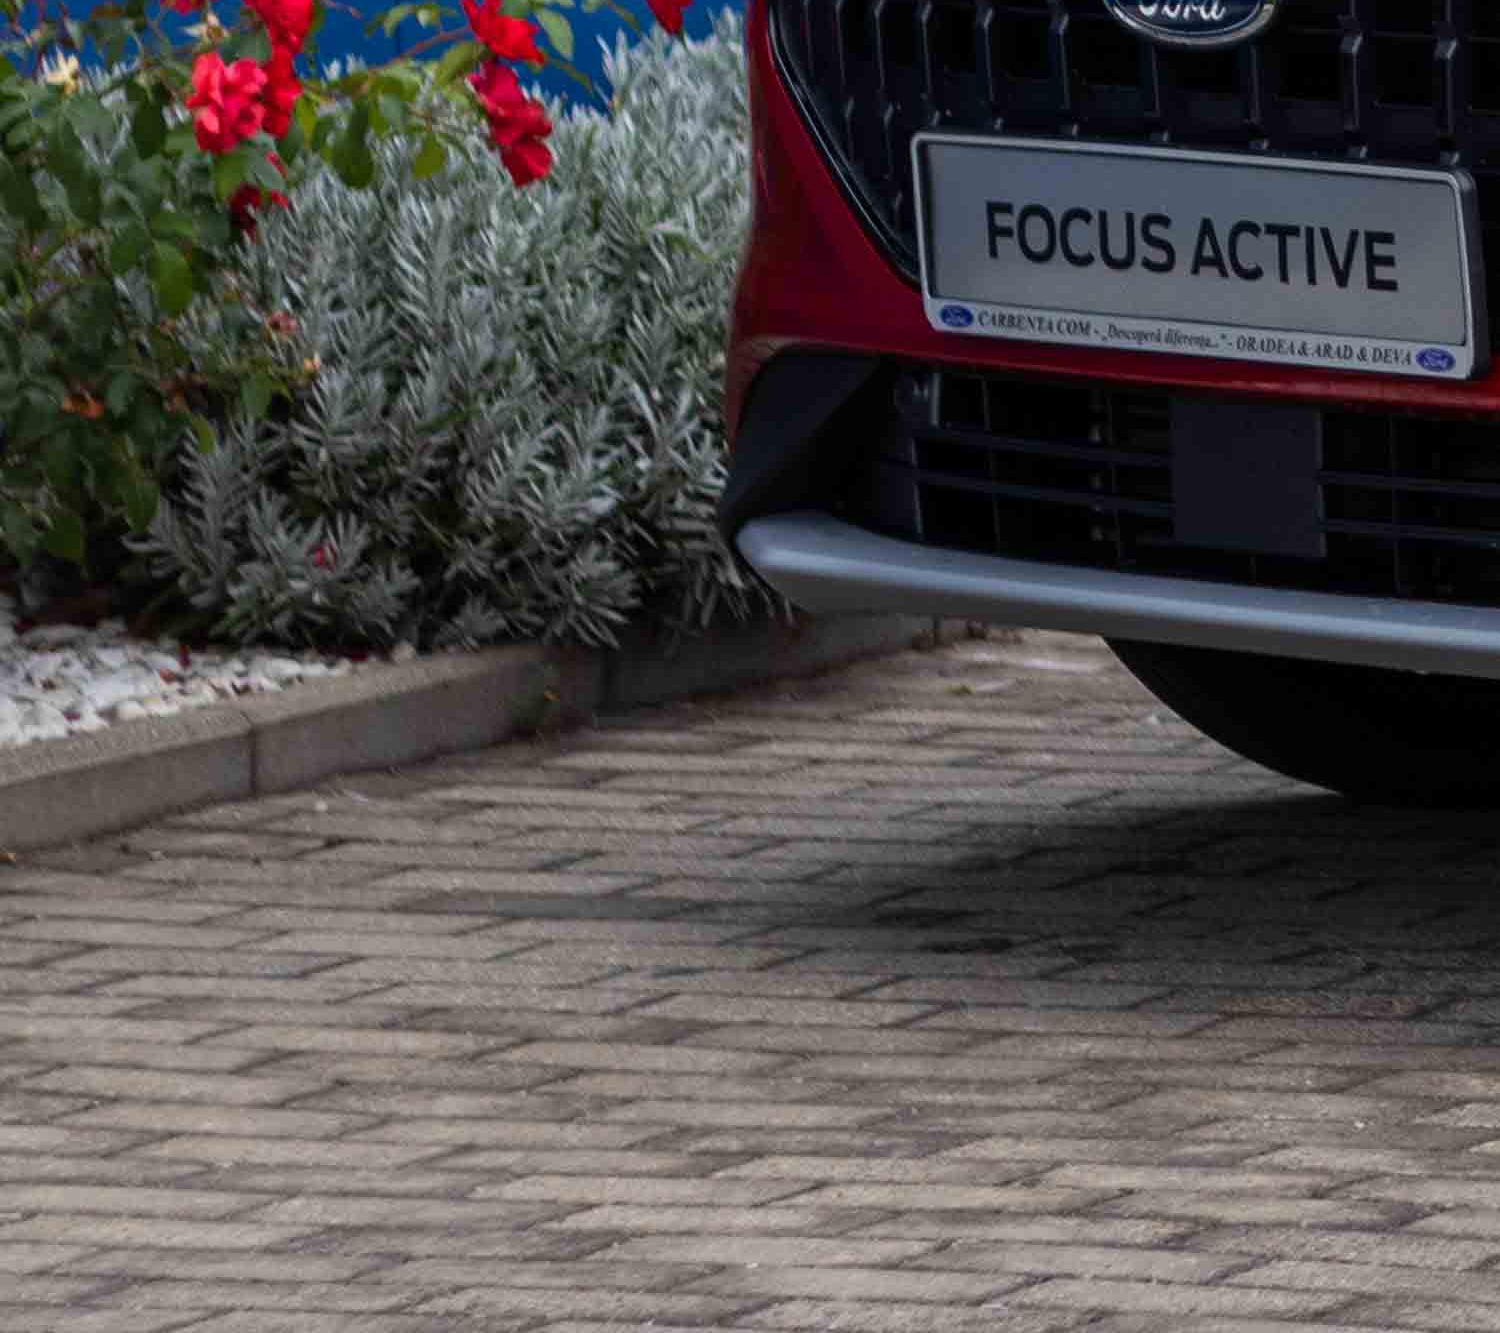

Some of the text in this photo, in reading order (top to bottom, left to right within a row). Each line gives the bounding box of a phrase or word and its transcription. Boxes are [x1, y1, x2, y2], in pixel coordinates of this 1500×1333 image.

[984, 200, 1399, 292] FOCUS ACTIVE
[978, 308, 1054, 334] CARBENTA
[1056, 318, 1092, 337] COM
[1236, 334, 1296, 355] ORADEA
[1297, 342, 1309, 357] &
[1313, 342, 1355, 360] ARAD
[1357, 345, 1369, 361] &
[1371, 347, 1412, 366] DEVA
